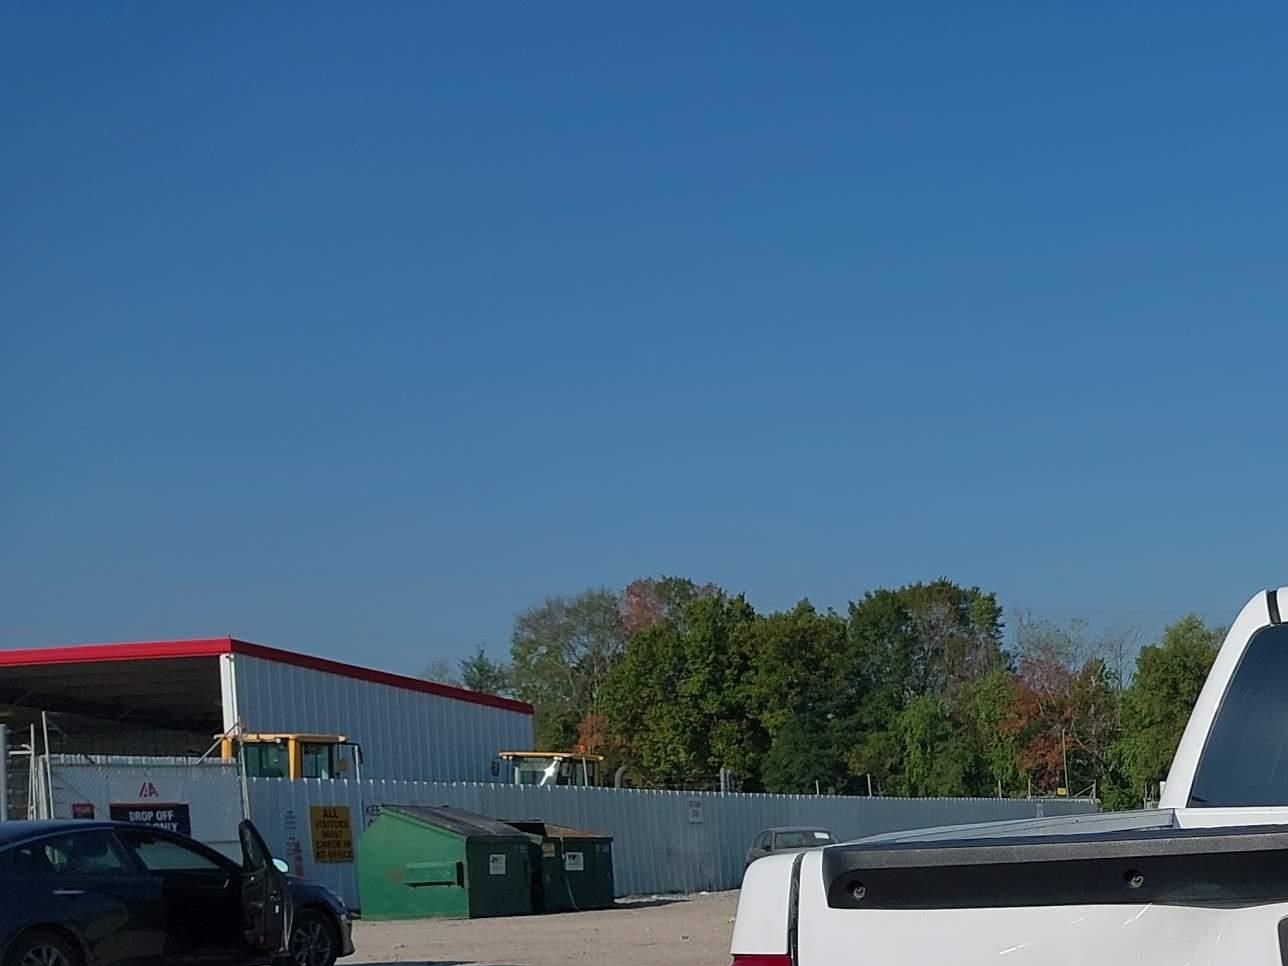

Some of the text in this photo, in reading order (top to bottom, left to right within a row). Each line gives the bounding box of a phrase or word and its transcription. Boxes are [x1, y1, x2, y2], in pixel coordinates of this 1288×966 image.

[129, 810, 175, 822] DROP OFF
[322, 808, 338, 818] ALL
[315, 819, 349, 829] VISITORS
[316, 839, 341, 849] CHECK
